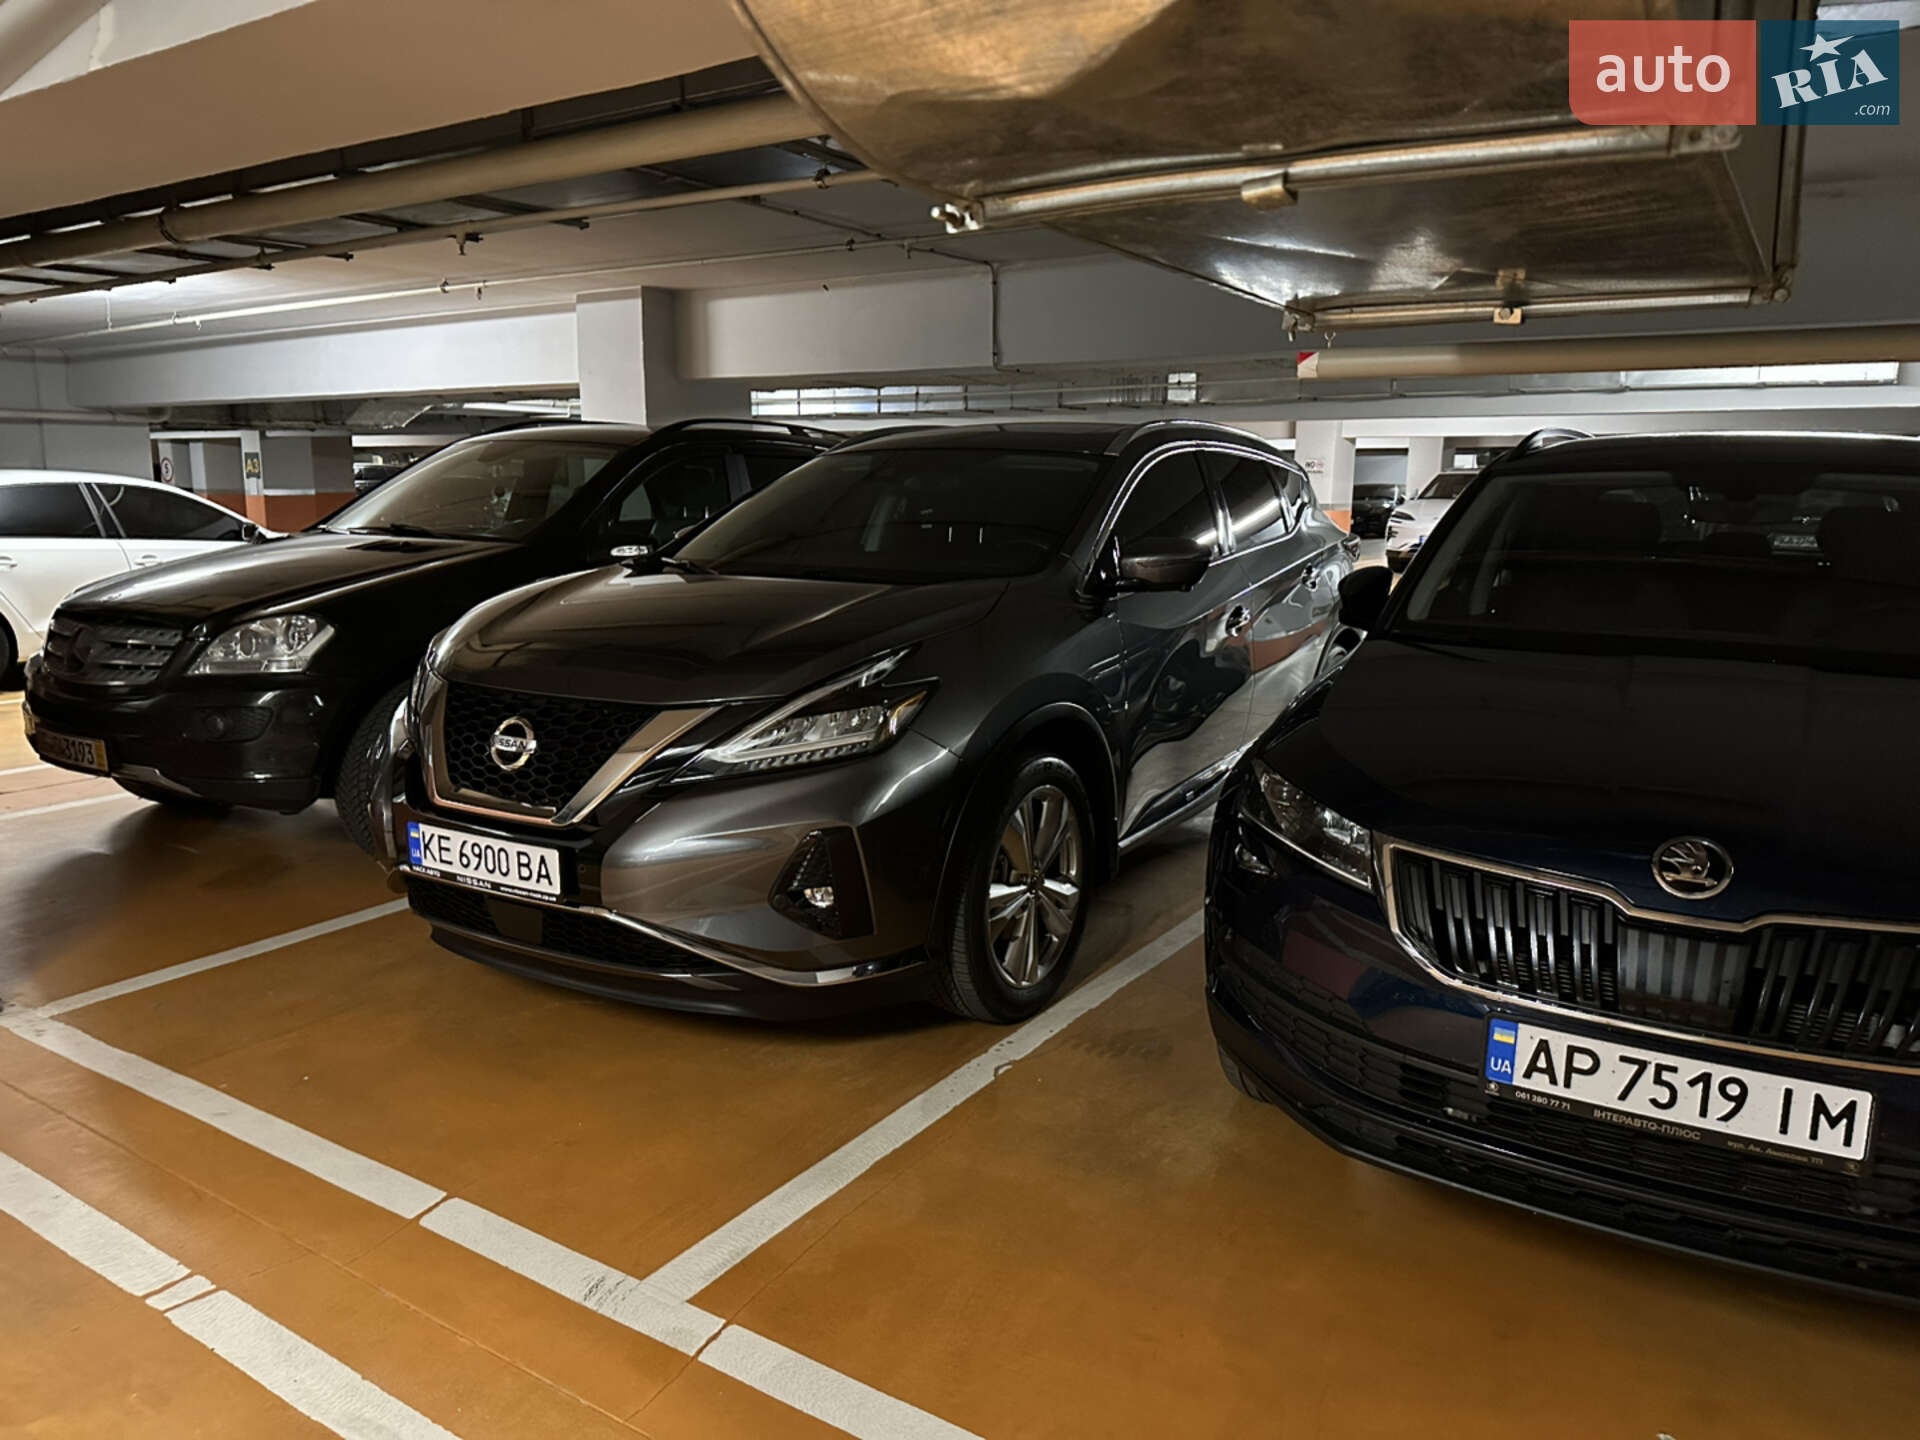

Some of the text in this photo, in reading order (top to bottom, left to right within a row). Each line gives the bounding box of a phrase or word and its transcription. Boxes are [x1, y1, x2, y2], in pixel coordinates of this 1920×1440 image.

[246, 458, 260, 473] A3
[63, 738, 95, 765] 3193
[422, 831, 552, 886] KE 6900 BA
[456, 875, 492, 889] NISSAN
[1491, 1058, 1512, 1075] UA
[1522, 1038, 1857, 1148] AP 7519 IM
